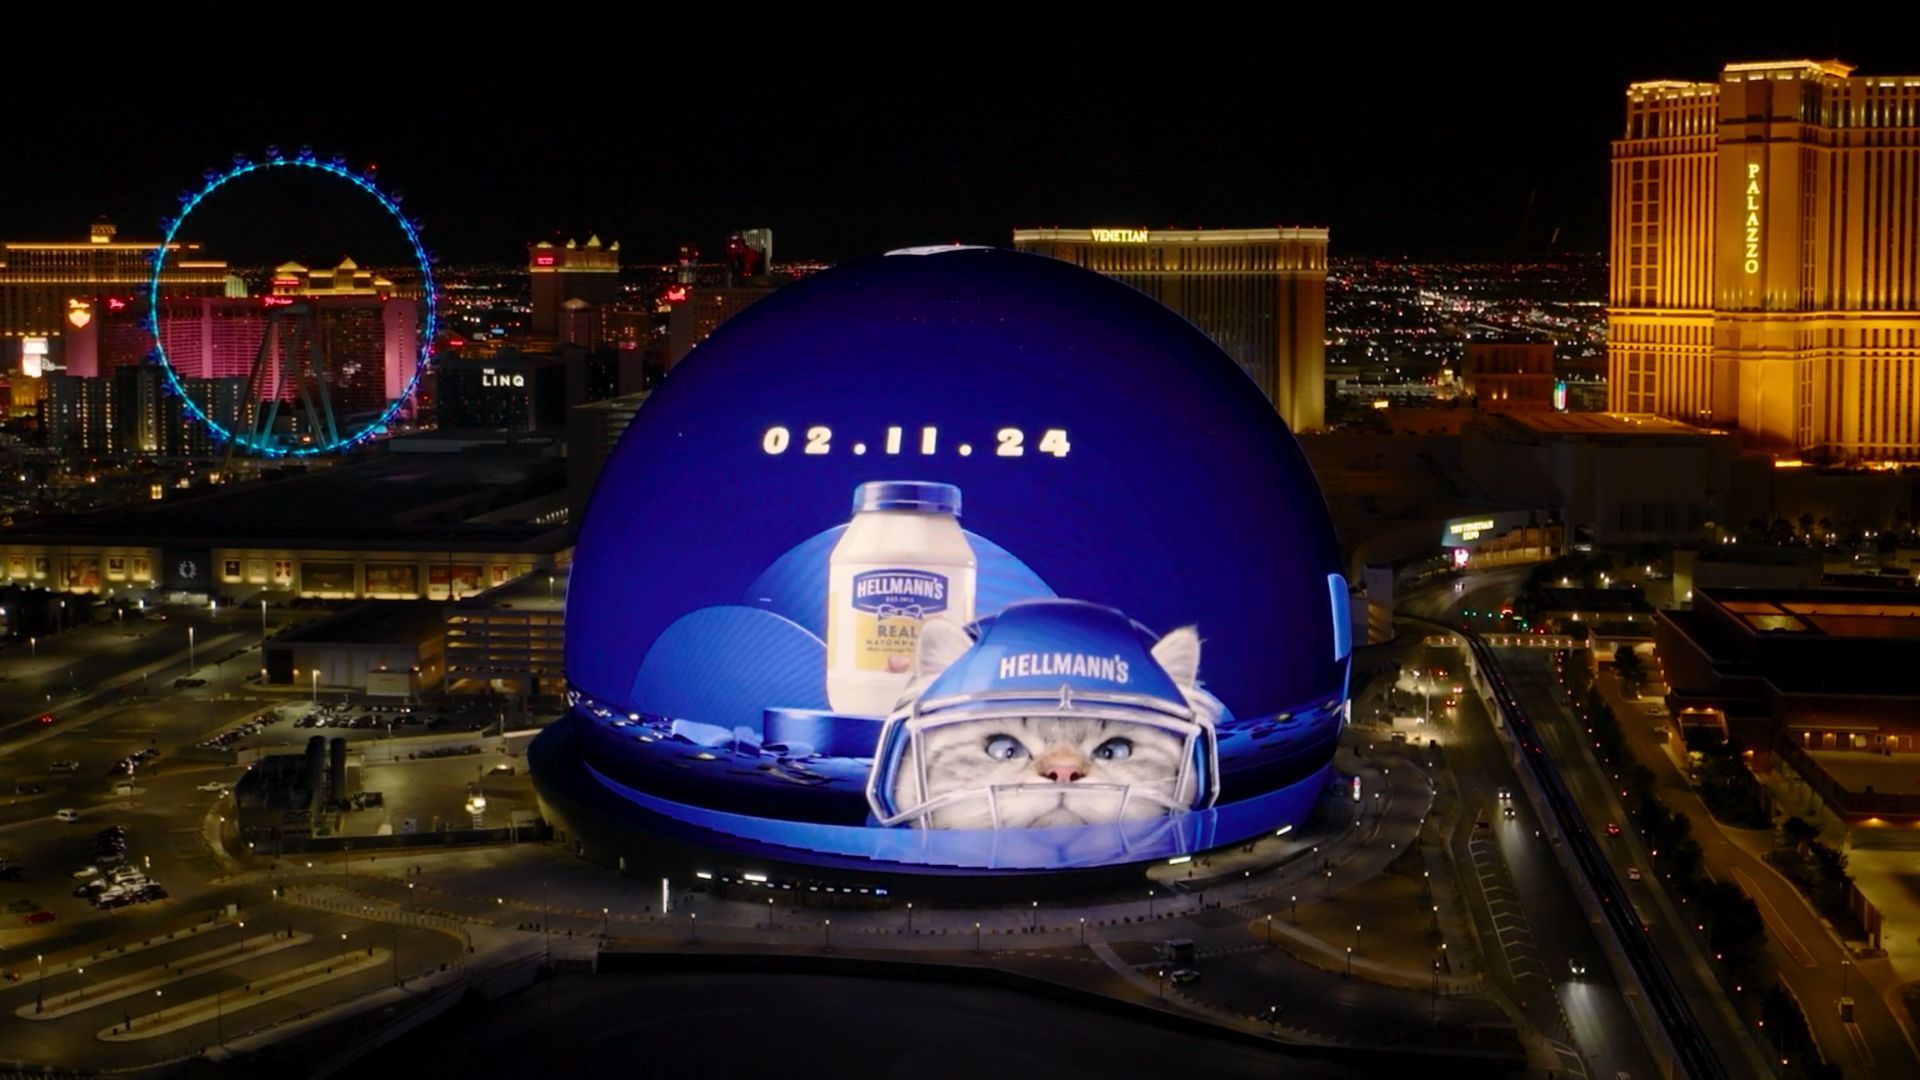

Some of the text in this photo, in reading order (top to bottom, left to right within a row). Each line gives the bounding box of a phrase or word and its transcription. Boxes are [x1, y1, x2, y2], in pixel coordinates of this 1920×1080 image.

[1745, 163, 1760, 274] PALAZZO
[1092, 229, 1148, 242] VENETIAN
[483, 375, 524, 387] LINQ
[857, 578, 943, 599] HELLMANN'S
[877, 624, 919, 638] REAL
[999, 653, 1129, 684] HELLMANN'S
